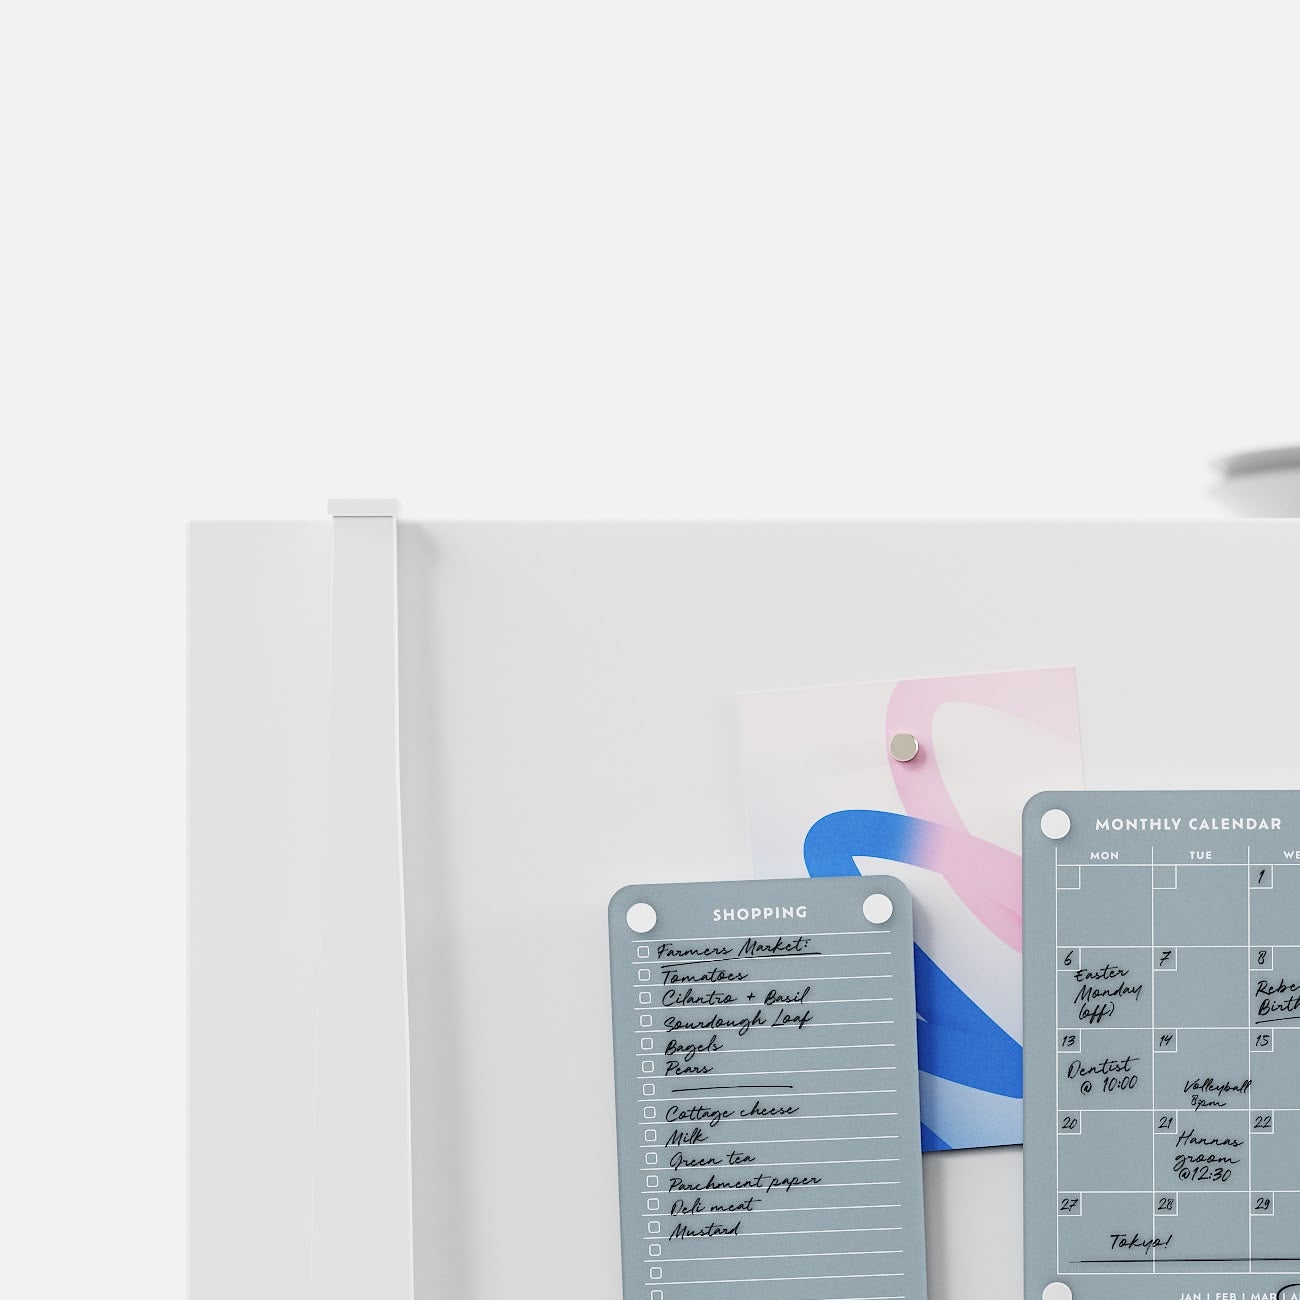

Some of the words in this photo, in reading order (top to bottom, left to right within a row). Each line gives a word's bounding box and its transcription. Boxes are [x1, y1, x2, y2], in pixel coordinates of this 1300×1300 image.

[1095, 817, 1182, 832] MONTHLY
[1188, 817, 1282, 831] CALENDAR
[1089, 850, 1119, 861] MON
[1188, 849, 1213, 861] TUE
[1257, 870, 1266, 884] 1
[712, 905, 808, 922] SHOPPING
[658, 943, 733, 959] Farmers
[1063, 951, 1074, 966] 6
[1159, 951, 1172, 966] 7
[1257, 951, 1267, 964] 8
[661, 965, 748, 986] Tomatoes
[1074, 964, 1129, 982] Easter
[662, 988, 737, 1007] Cilantro
[764, 987, 810, 1005] Basil
[1074, 982, 1143, 1004] Monday
[664, 1010, 767, 1036] Sourdough
[771, 1009, 813, 1029] Loaf
[665, 1035, 723, 1062] Bagels
[1062, 1035, 1076, 1047] 13
[1160, 1035, 1173, 1047] 14
[1256, 1035, 1270, 1046] 15
[665, 1059, 713, 1076] Pears
[1068, 1056, 1139, 1080] Dentist
[1184, 1078, 1252, 1096] Volleyball
[666, 1106, 735, 1127] Cottage
[740, 1101, 799, 1116] cheese
[1158, 1116, 1173, 1128] 21
[1254, 1116, 1271, 1128] 22
[1062, 1117, 1077, 1129] 20
[665, 1128, 708, 1148] Milk
[1176, 1129, 1244, 1147] Hannas
[670, 1152, 723, 1171] Green
[726, 1151, 755, 1165] tea
[1173, 1154, 1240, 1173] groom
[669, 1174, 772, 1193] Parchment
[766, 1177, 822, 1193] paper
[671, 1198, 705, 1216] Deli
[710, 1197, 762, 1211] meat
[1060, 1199, 1078, 1211] 27
[1158, 1198, 1174, 1210] 28
[1255, 1198, 1270, 1210] 29
[669, 1221, 740, 1241] Mustard
[1110, 1233, 1172, 1255] Tokyo!
